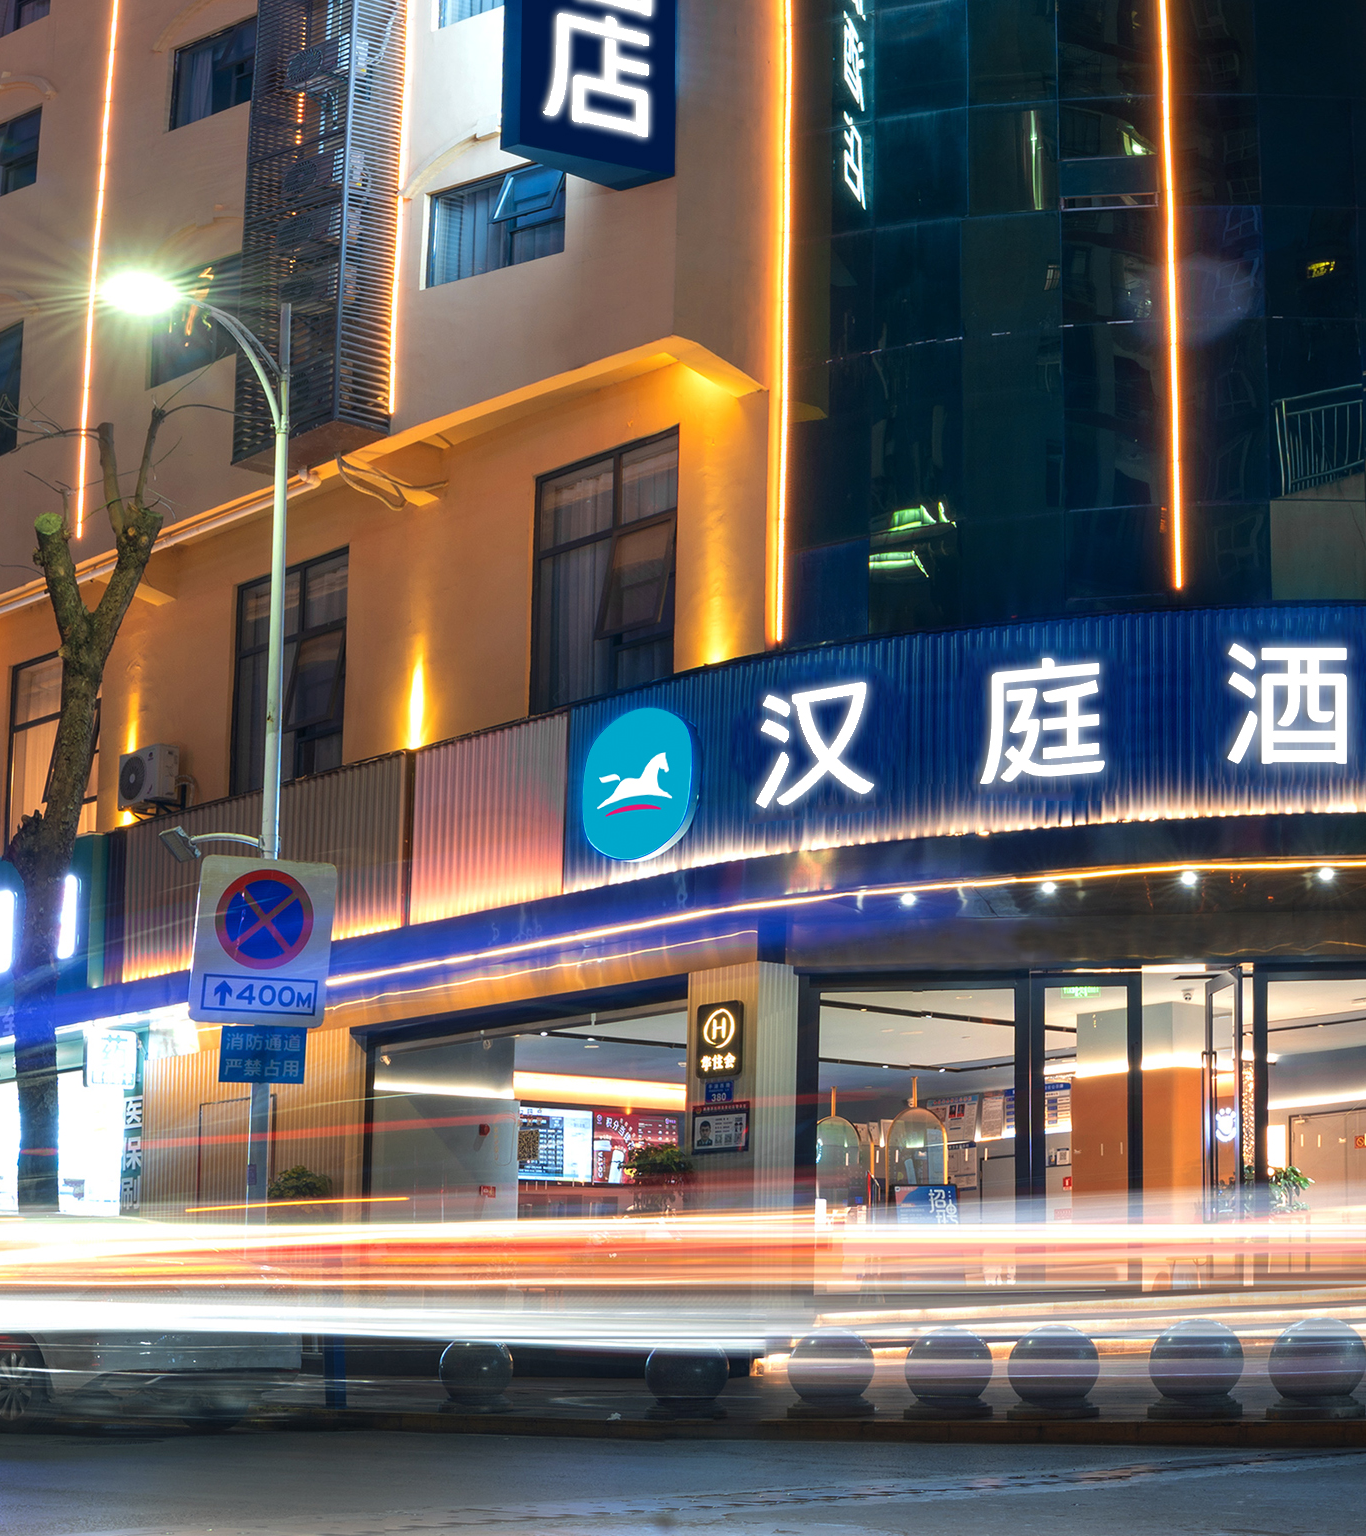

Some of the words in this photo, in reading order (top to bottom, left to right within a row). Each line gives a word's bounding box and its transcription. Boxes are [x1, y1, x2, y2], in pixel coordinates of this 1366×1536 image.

[236, 983, 313, 1008] 400M
[225, 1032, 302, 1052] 消防通道
[223, 1058, 300, 1077] 严禁占用
[700, 1051, 737, 1072] 华住会
[711, 1092, 727, 1103] 380
